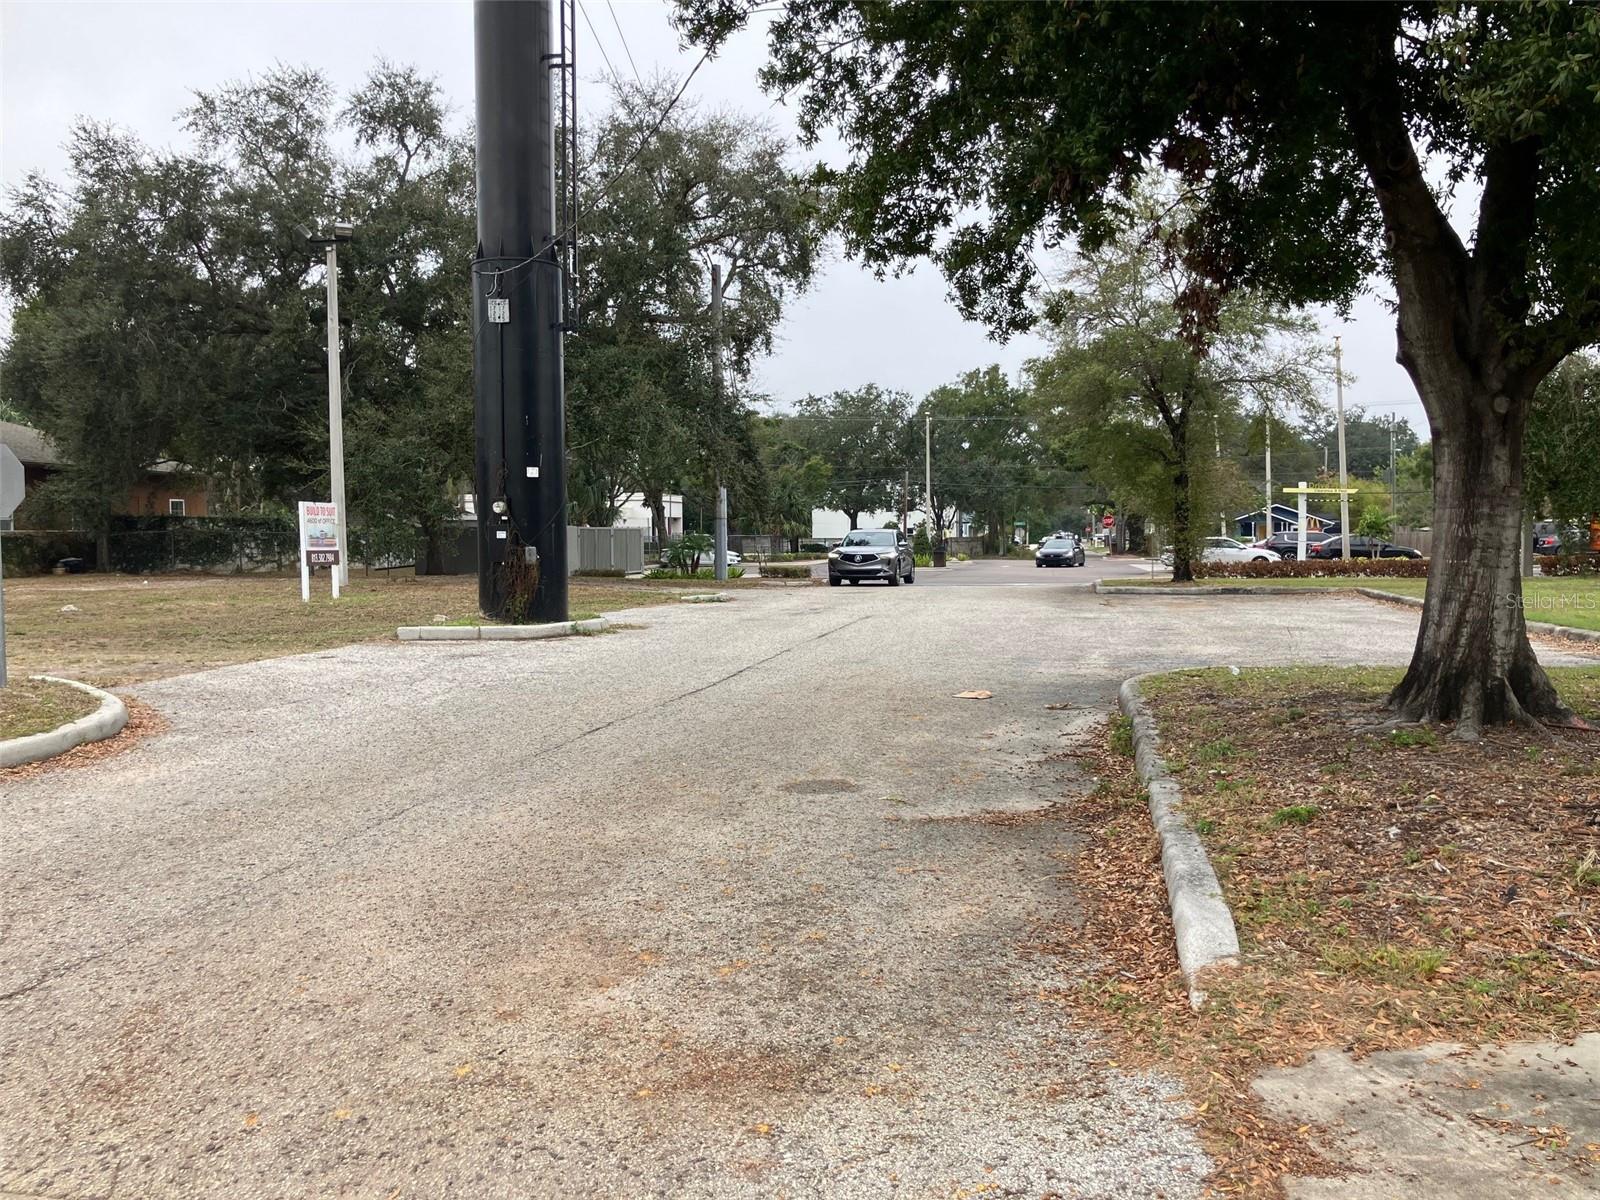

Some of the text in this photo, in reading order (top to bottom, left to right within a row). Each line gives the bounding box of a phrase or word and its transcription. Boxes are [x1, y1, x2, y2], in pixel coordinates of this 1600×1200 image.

[306, 506, 336, 516] BUILD TO SUIT
